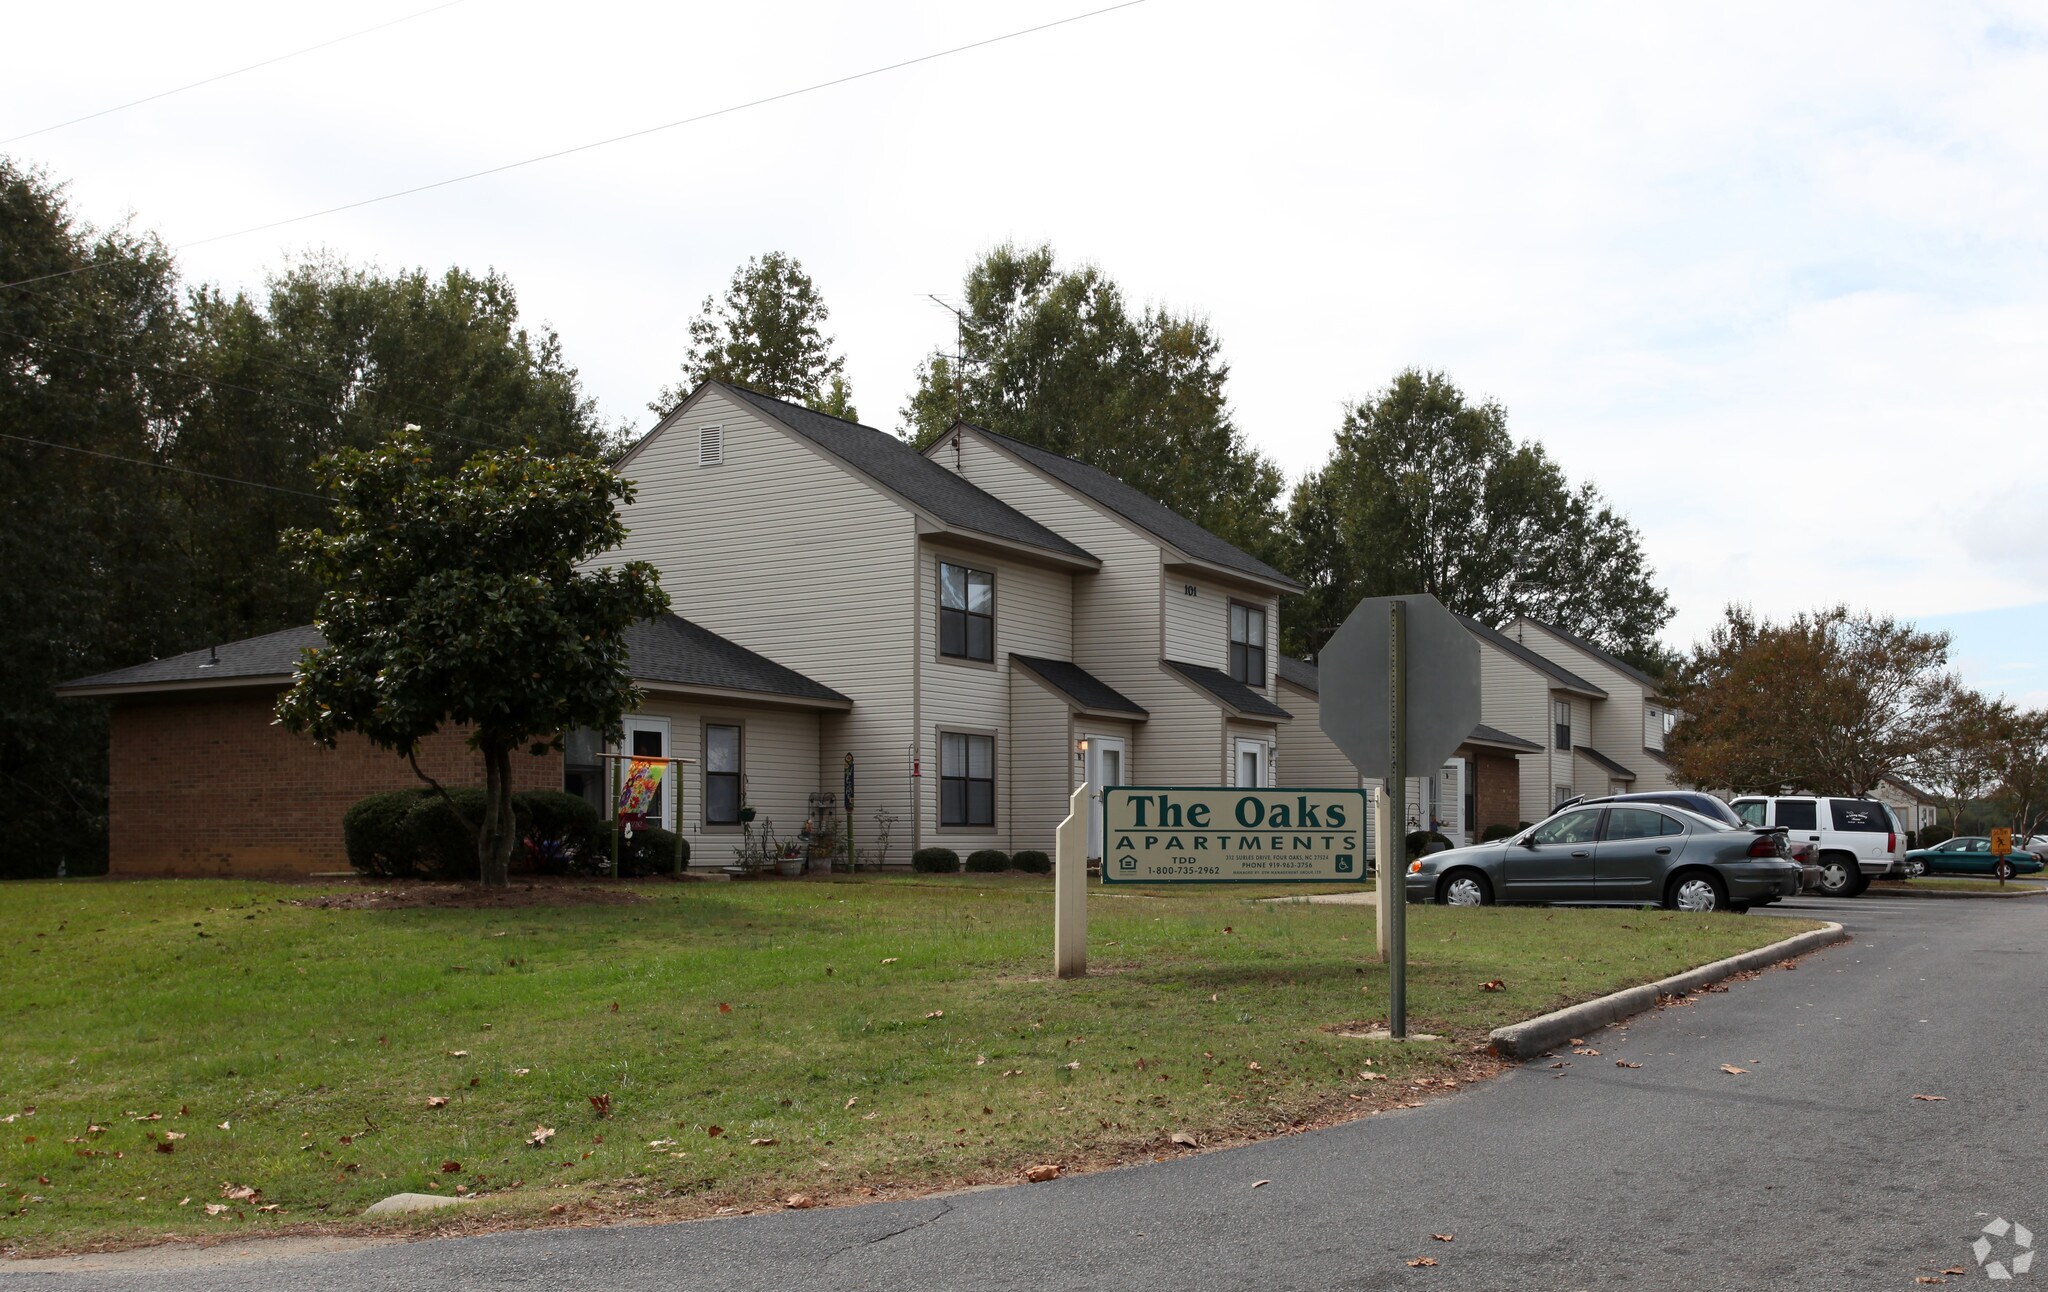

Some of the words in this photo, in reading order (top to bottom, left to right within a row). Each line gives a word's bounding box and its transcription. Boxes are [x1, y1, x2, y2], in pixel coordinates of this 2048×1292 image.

[1184, 584, 1197, 597] 101
[1127, 794, 1211, 828] The
[1235, 796, 1346, 828] Oaks
[1116, 836, 1356, 850] APARTMENTS
[1172, 856, 1196, 864] TDD
[1148, 866, 1220, 875] 1-800-735-2962
